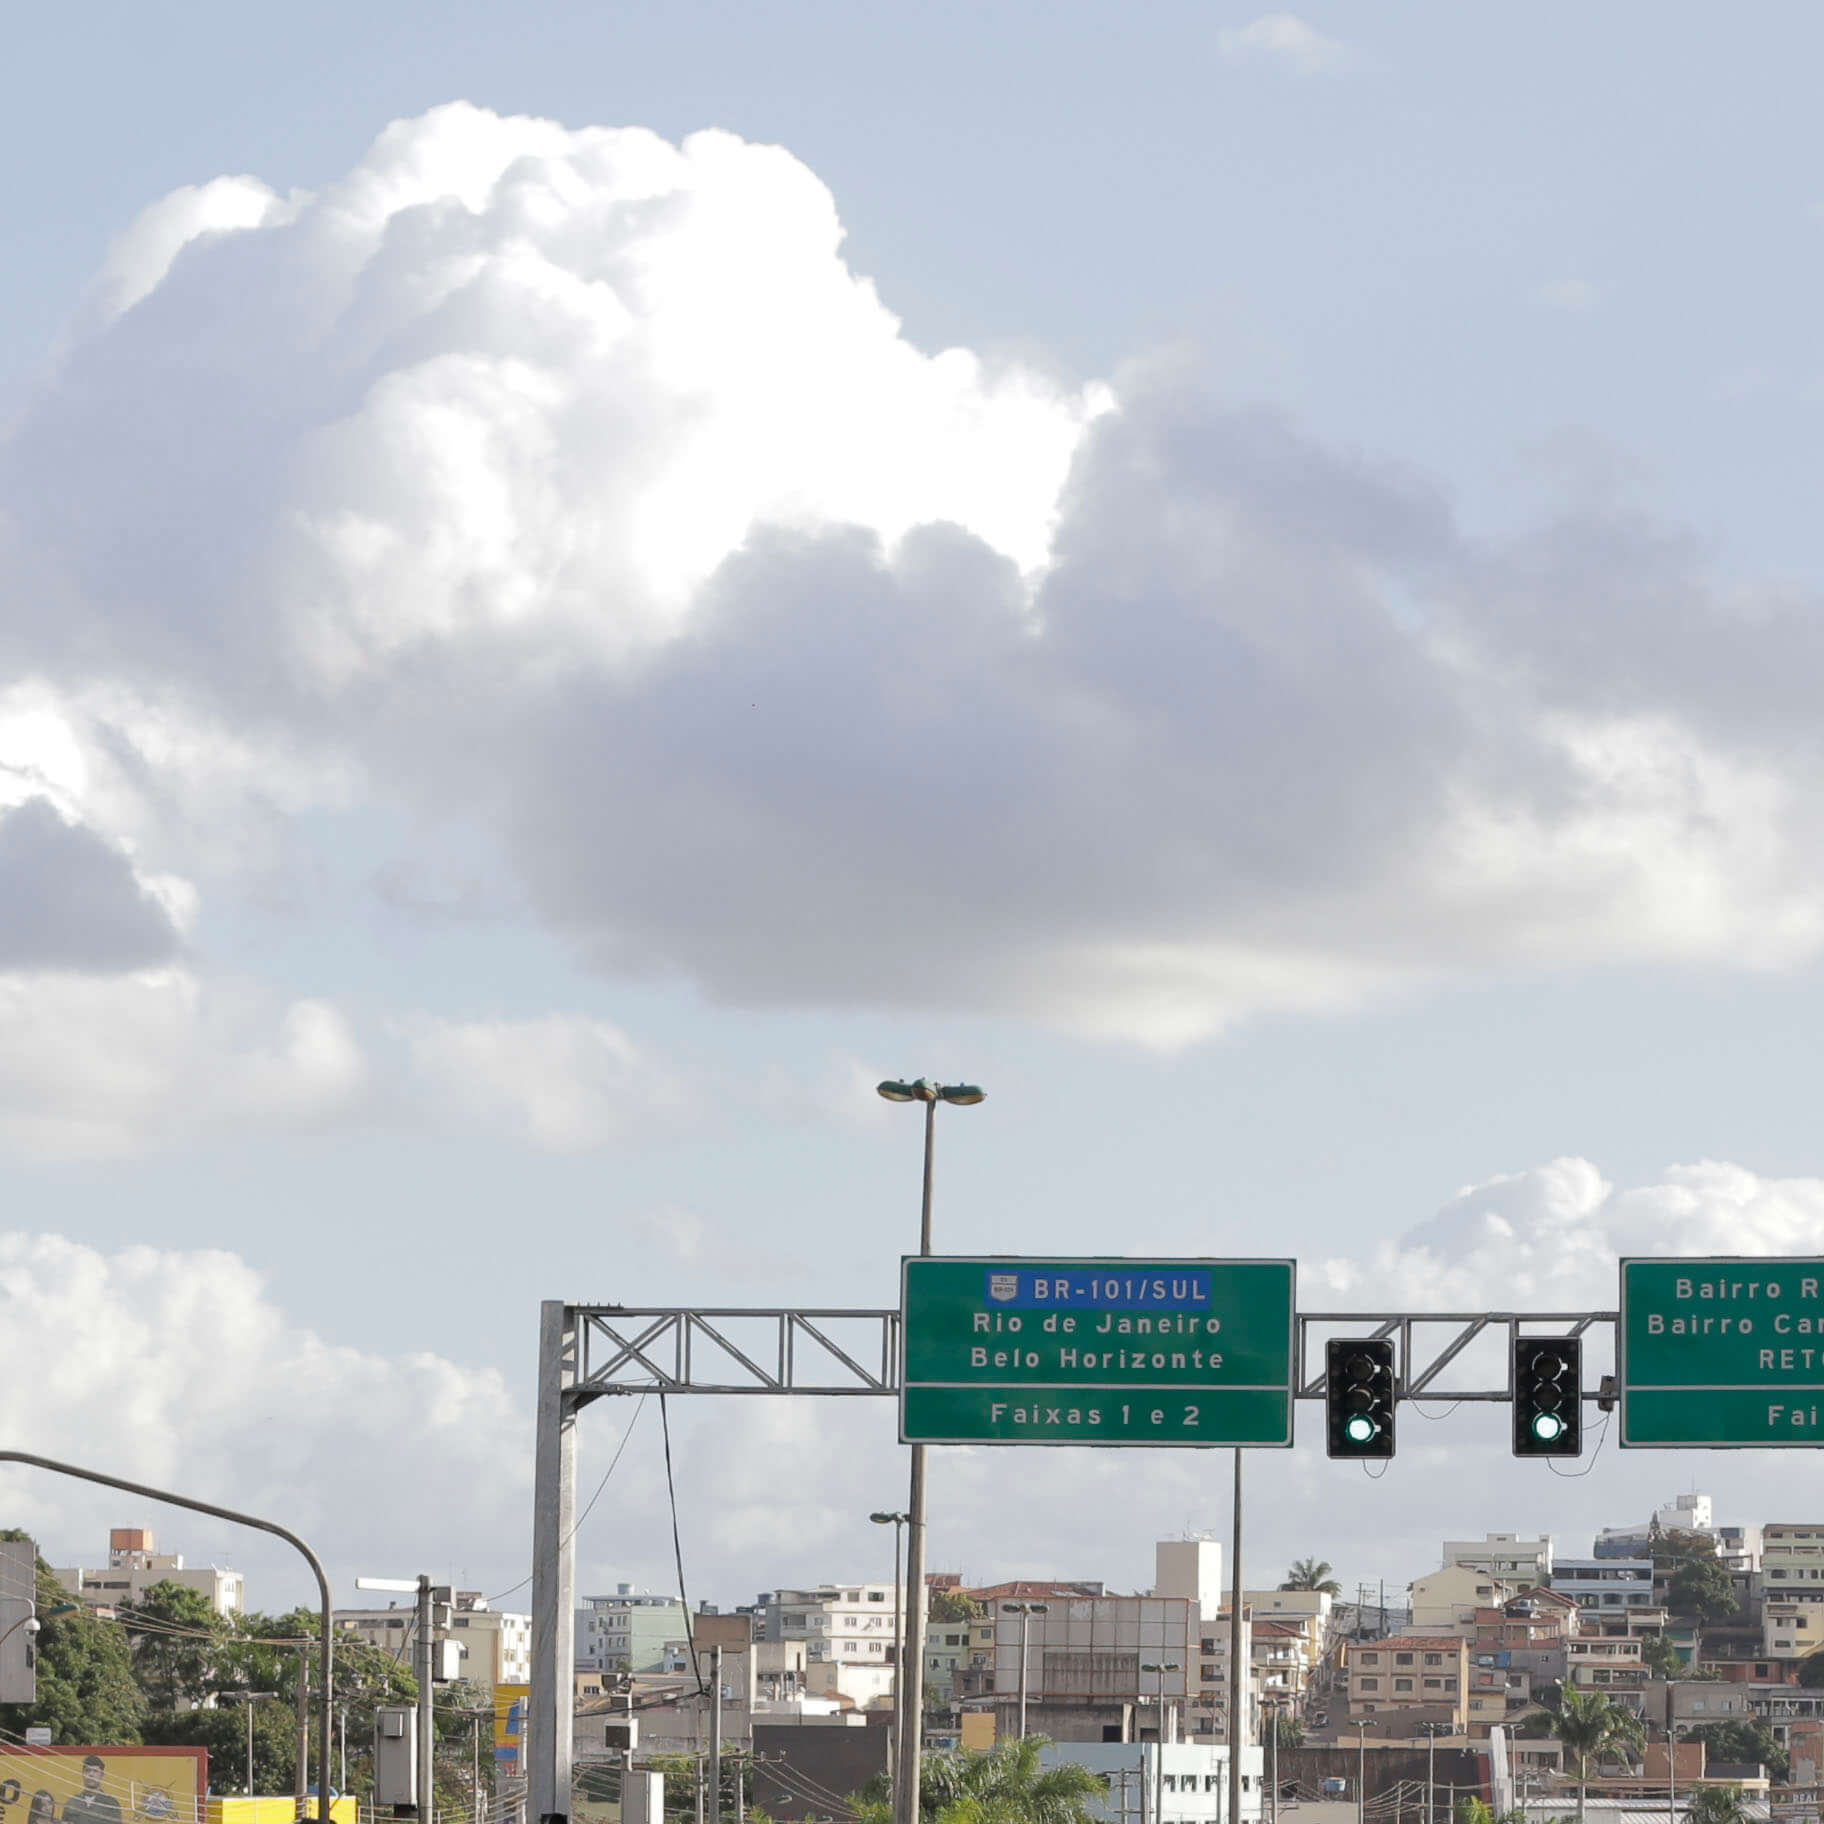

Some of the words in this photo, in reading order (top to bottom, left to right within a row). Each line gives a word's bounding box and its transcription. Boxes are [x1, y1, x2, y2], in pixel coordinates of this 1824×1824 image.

[1033, 1278, 1207, 1301] BR-101/SUL
[1675, 1277, 1782, 1300] Bairro
[973, 1312, 1023, 1334] Rio
[1042, 1312, 1077, 1334] de
[1095, 1313, 1222, 1335] Janeiro
[1647, 1312, 1754, 1335] Bairro
[970, 1346, 1040, 1369] Belo
[1059, 1348, 1225, 1370] Horizonte
[991, 1402, 1102, 1426] Faixas
[1121, 1404, 1130, 1426] 1
[1150, 1408, 1165, 1426] e
[1182, 1405, 1201, 1427] 2
